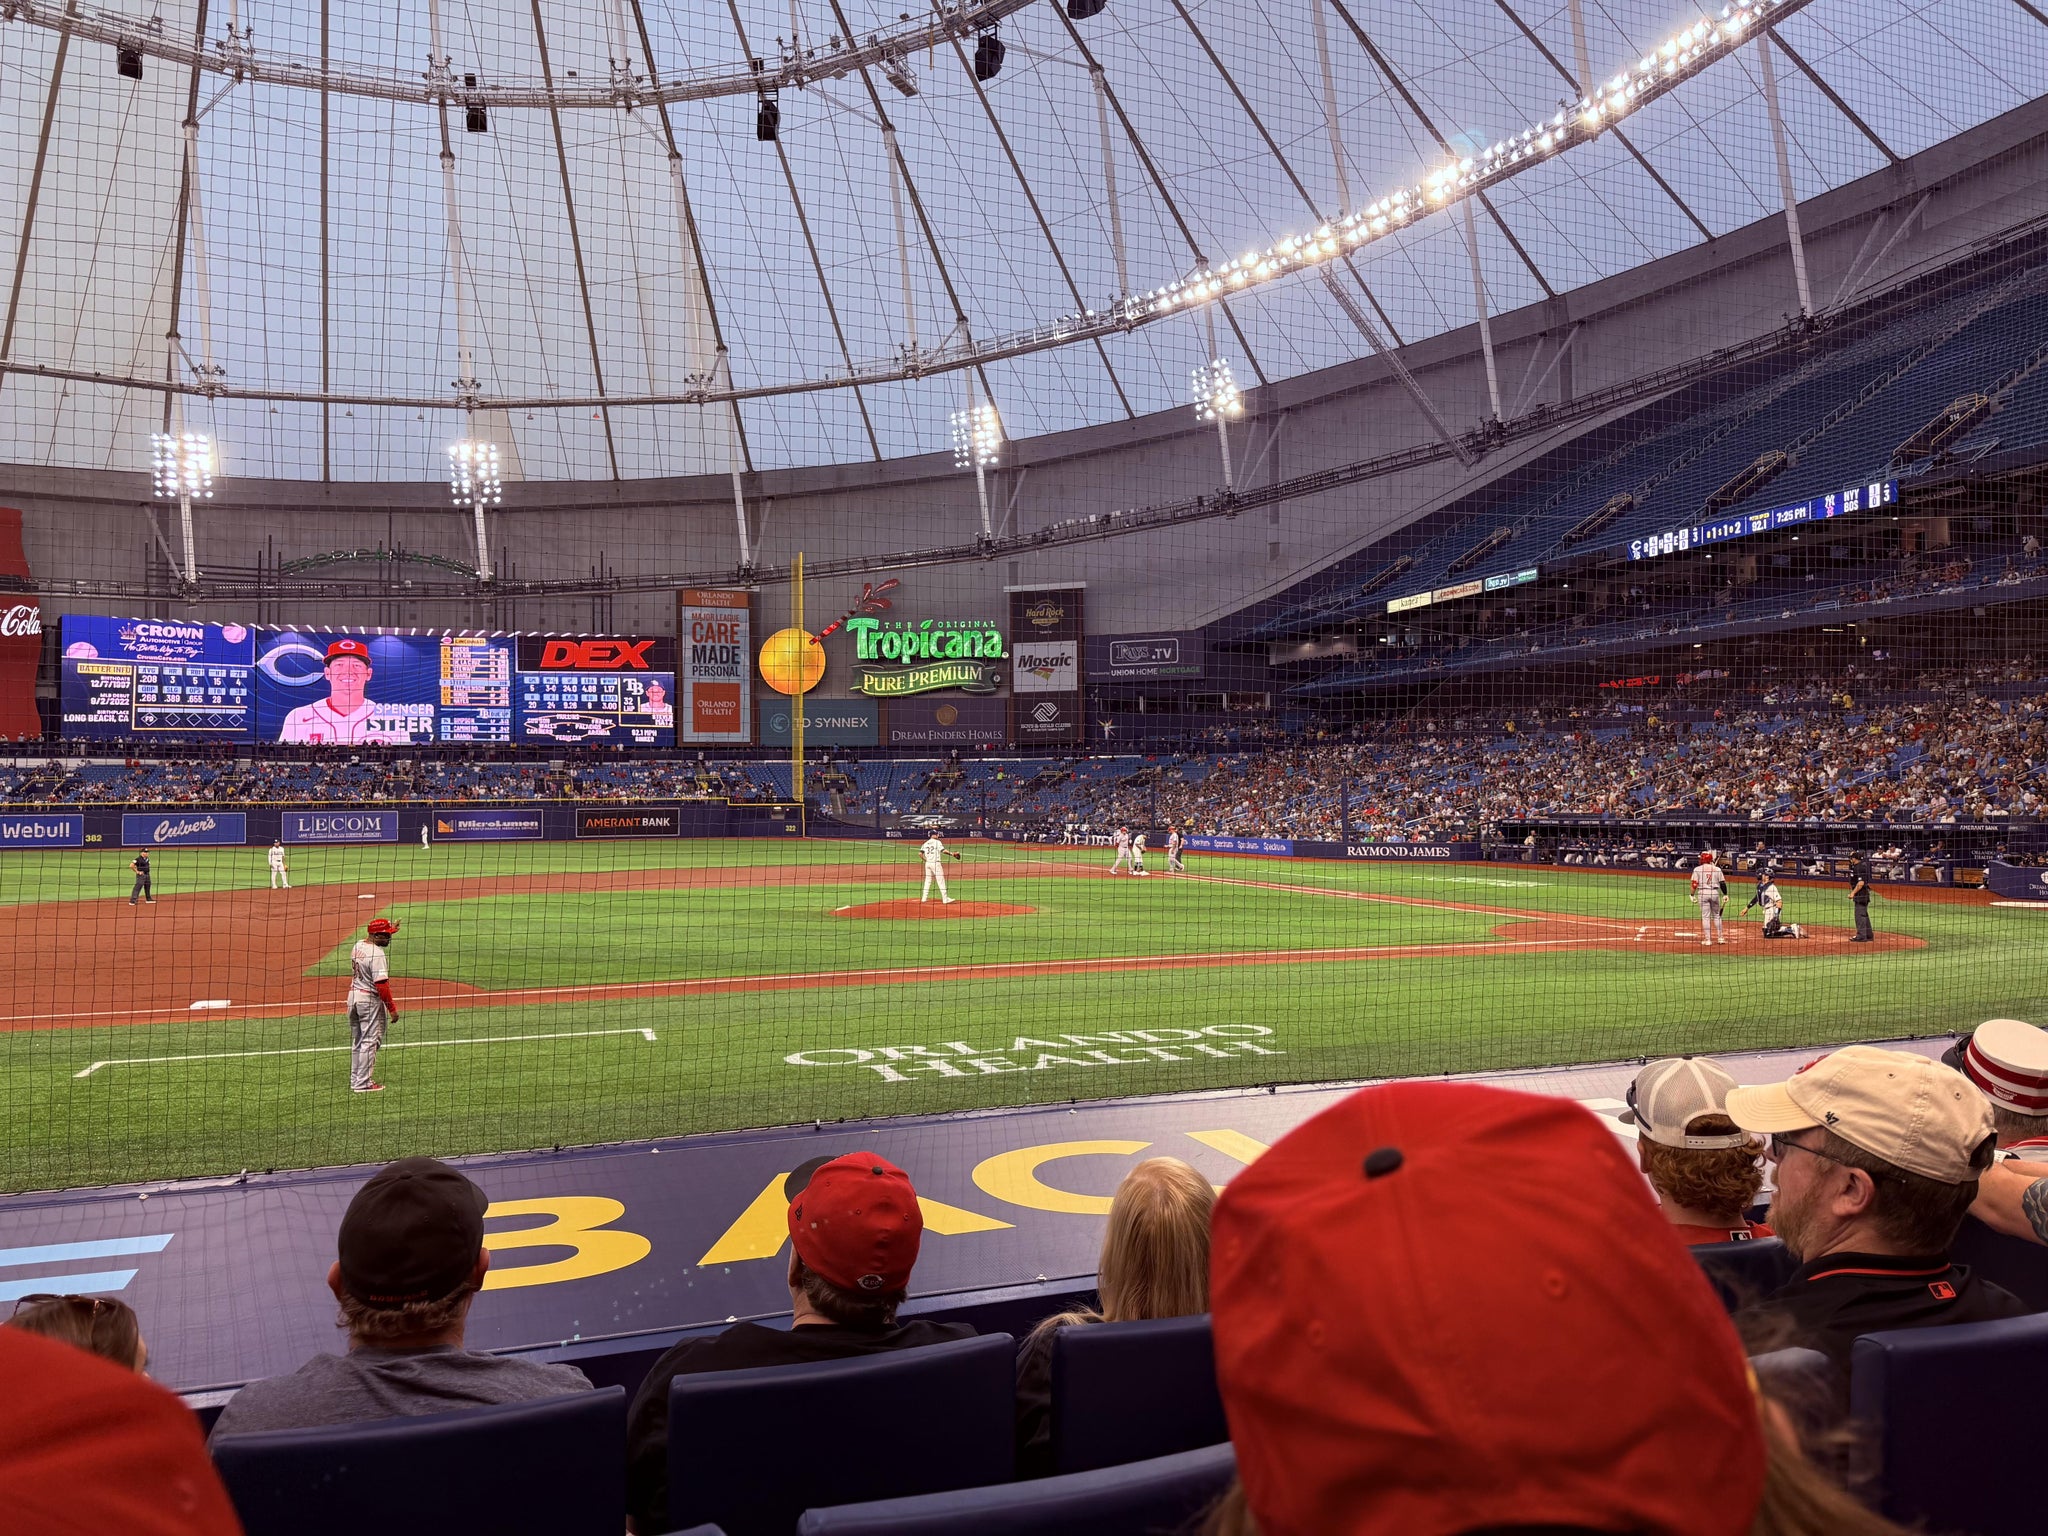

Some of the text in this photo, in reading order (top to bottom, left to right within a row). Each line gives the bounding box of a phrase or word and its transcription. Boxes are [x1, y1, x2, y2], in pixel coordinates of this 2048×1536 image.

[1844, 500, 1859, 512] BOS
[1884, 489, 1890, 502] 3
[1776, 510, 1794, 523] 7:25
[1794, 507, 1806, 519] PM
[1723, 524, 1728, 537] 1
[1734, 521, 1741, 534] 2
[1752, 520, 1767, 532] 92.1
[1673, 535, 1679, 546] E
[1693, 531, 1698, 542] 3
[697, 591, 735, 600] ORLANDO
[701, 599, 731, 607] HEALTH
[691, 612, 740, 622] MAJOR LEAGUE
[1026, 607, 1064, 618] Hard Rock
[1, 604, 41, 637] Cola
[884, 620, 996, 629] THE ORIGINAL
[135, 623, 204, 640] CROWN
[691, 621, 740, 645] CARE
[846, 617, 1003, 664] Tropicana
[540, 640, 656, 669] DEX
[692, 644, 741, 665] MADE
[1017, 652, 1072, 669] Mosaic
[79, 664, 131, 674] BATTER INFO
[692, 665, 741, 677] PERSONAL
[1111, 668, 1135, 677] UNION
[1136, 667, 1159, 676] HOME
[1159, 666, 1201, 675] MORTGAGE
[170, 675, 176, 684] 3
[213, 677, 222, 685] 15
[235, 678, 242, 686] 4
[863, 665, 983, 692] PURE PREMIUM
[603, 685, 615, 693] 1.17
[235, 696, 241, 704] 0
[528, 701, 537, 709] 20
[546, 701, 556, 709] 24
[602, 702, 618, 710] 3.00
[623, 697, 634, 706] 32
[697, 699, 736, 708] ORLANDO
[375, 702, 435, 715] SPENCER
[701, 707, 732, 716] HEALTH
[63, 713, 130, 723] LONG BEACH, CA
[794, 717, 869, 728] TD SYNNEX
[369, 716, 433, 733] STEER
[428, 734, 435, 742] 7
[892, 729, 1003, 741] DREAM FINDERS HOMES
[458, 820, 539, 828] MicroLumen
[585, 817, 670, 827] AMERANT BANK
[3, 822, 70, 839] Webull
[153, 816, 217, 843] Culver's
[785, 824, 796, 832] 322
[85, 834, 102, 842] 382
[1346, 846, 1450, 857] RAYMOND JAMES
[783, 1024, 1274, 1066] ORLANDO
[859, 1038, 1287, 1082] HEALTH
